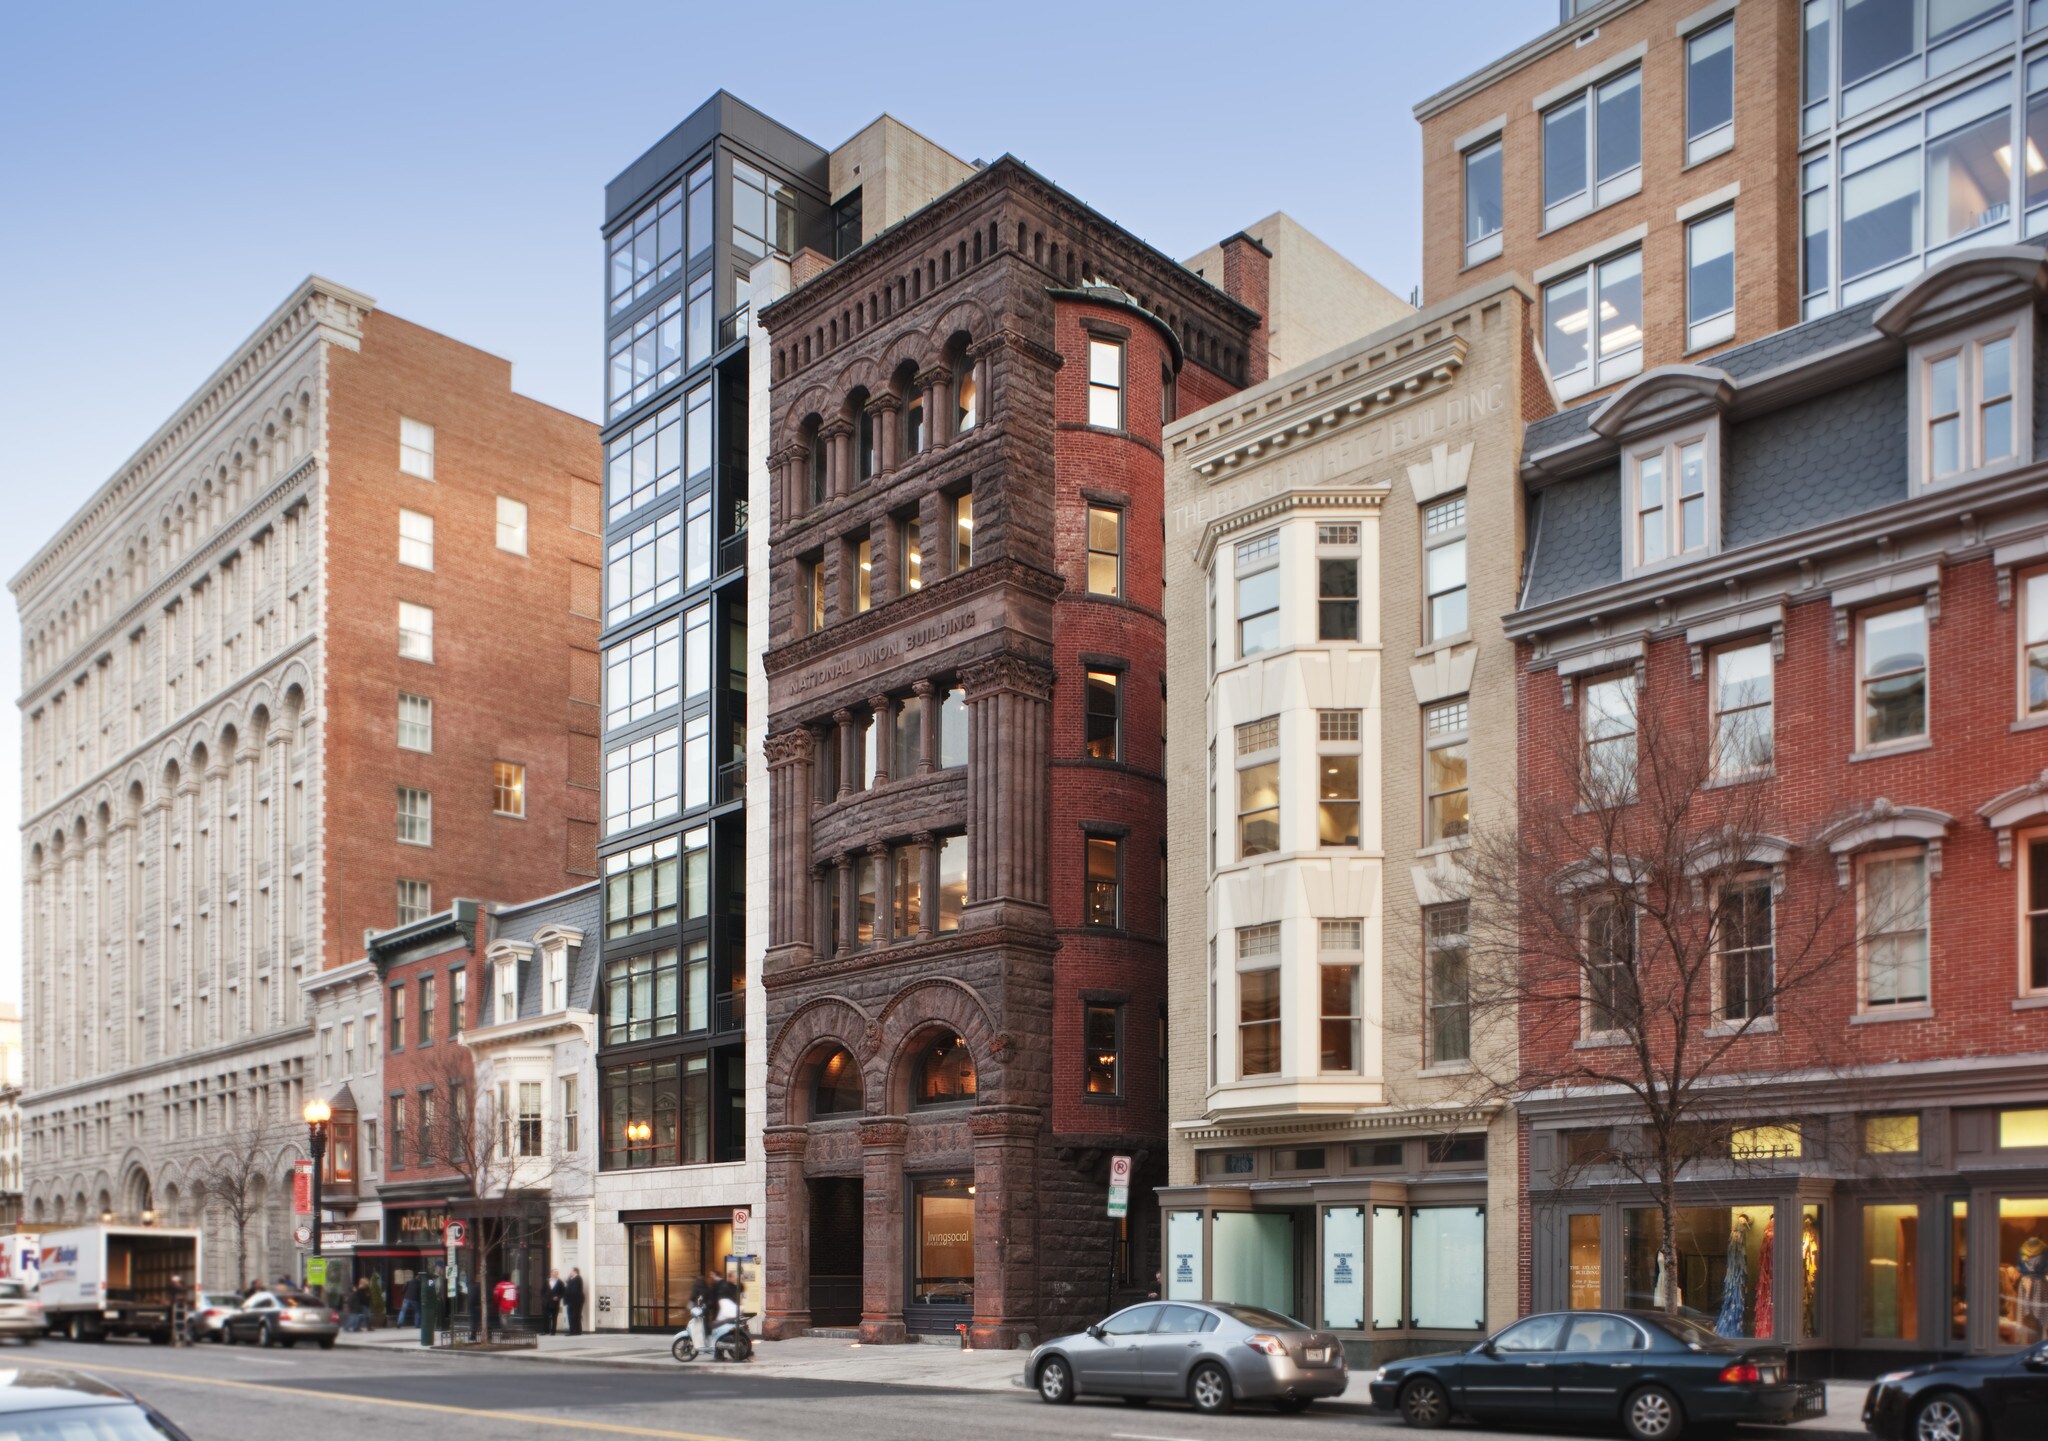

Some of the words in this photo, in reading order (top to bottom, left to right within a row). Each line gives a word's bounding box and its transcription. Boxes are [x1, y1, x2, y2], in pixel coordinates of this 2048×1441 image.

[1172, 496, 1209, 533] THE
[1215, 476, 1255, 517] BEN
[1391, 383, 1504, 448] BUILDING
[789, 660, 852, 695] NATIONAL
[856, 640, 900, 669] UNION
[906, 611, 976, 653] BUILDING
[402, 1216, 428, 1231] PIZZA
[927, 1230, 969, 1246] livingsocial
